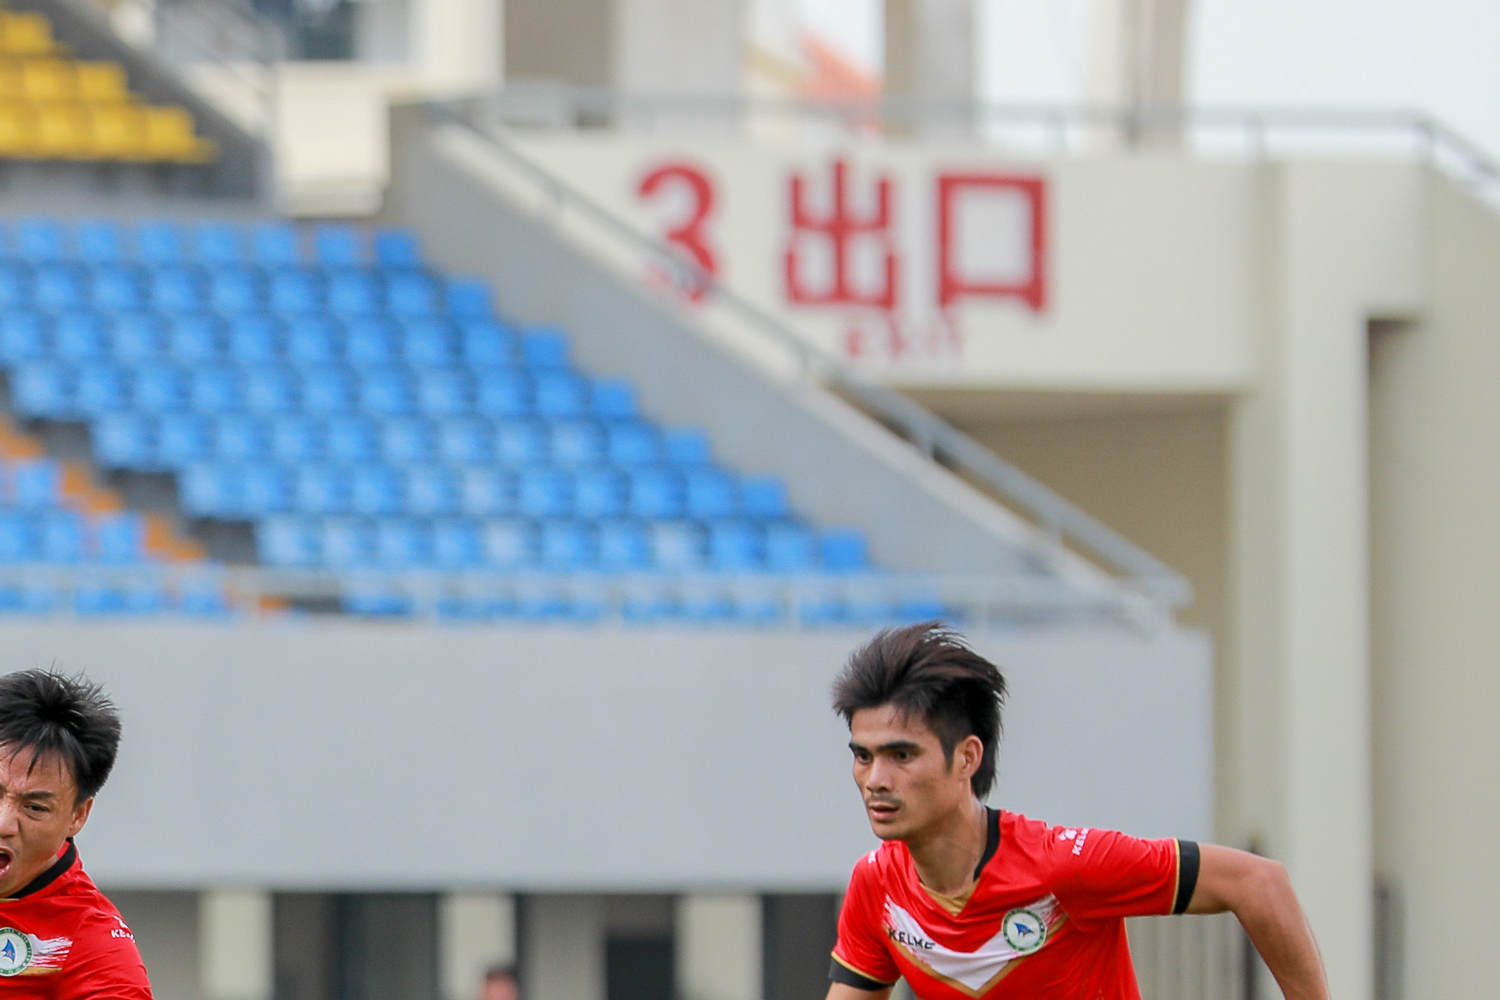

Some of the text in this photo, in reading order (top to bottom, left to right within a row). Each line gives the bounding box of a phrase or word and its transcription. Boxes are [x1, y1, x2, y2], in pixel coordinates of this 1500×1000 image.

[638, 159, 1046, 310] 3 出口
[889, 928, 935, 950] KELME
